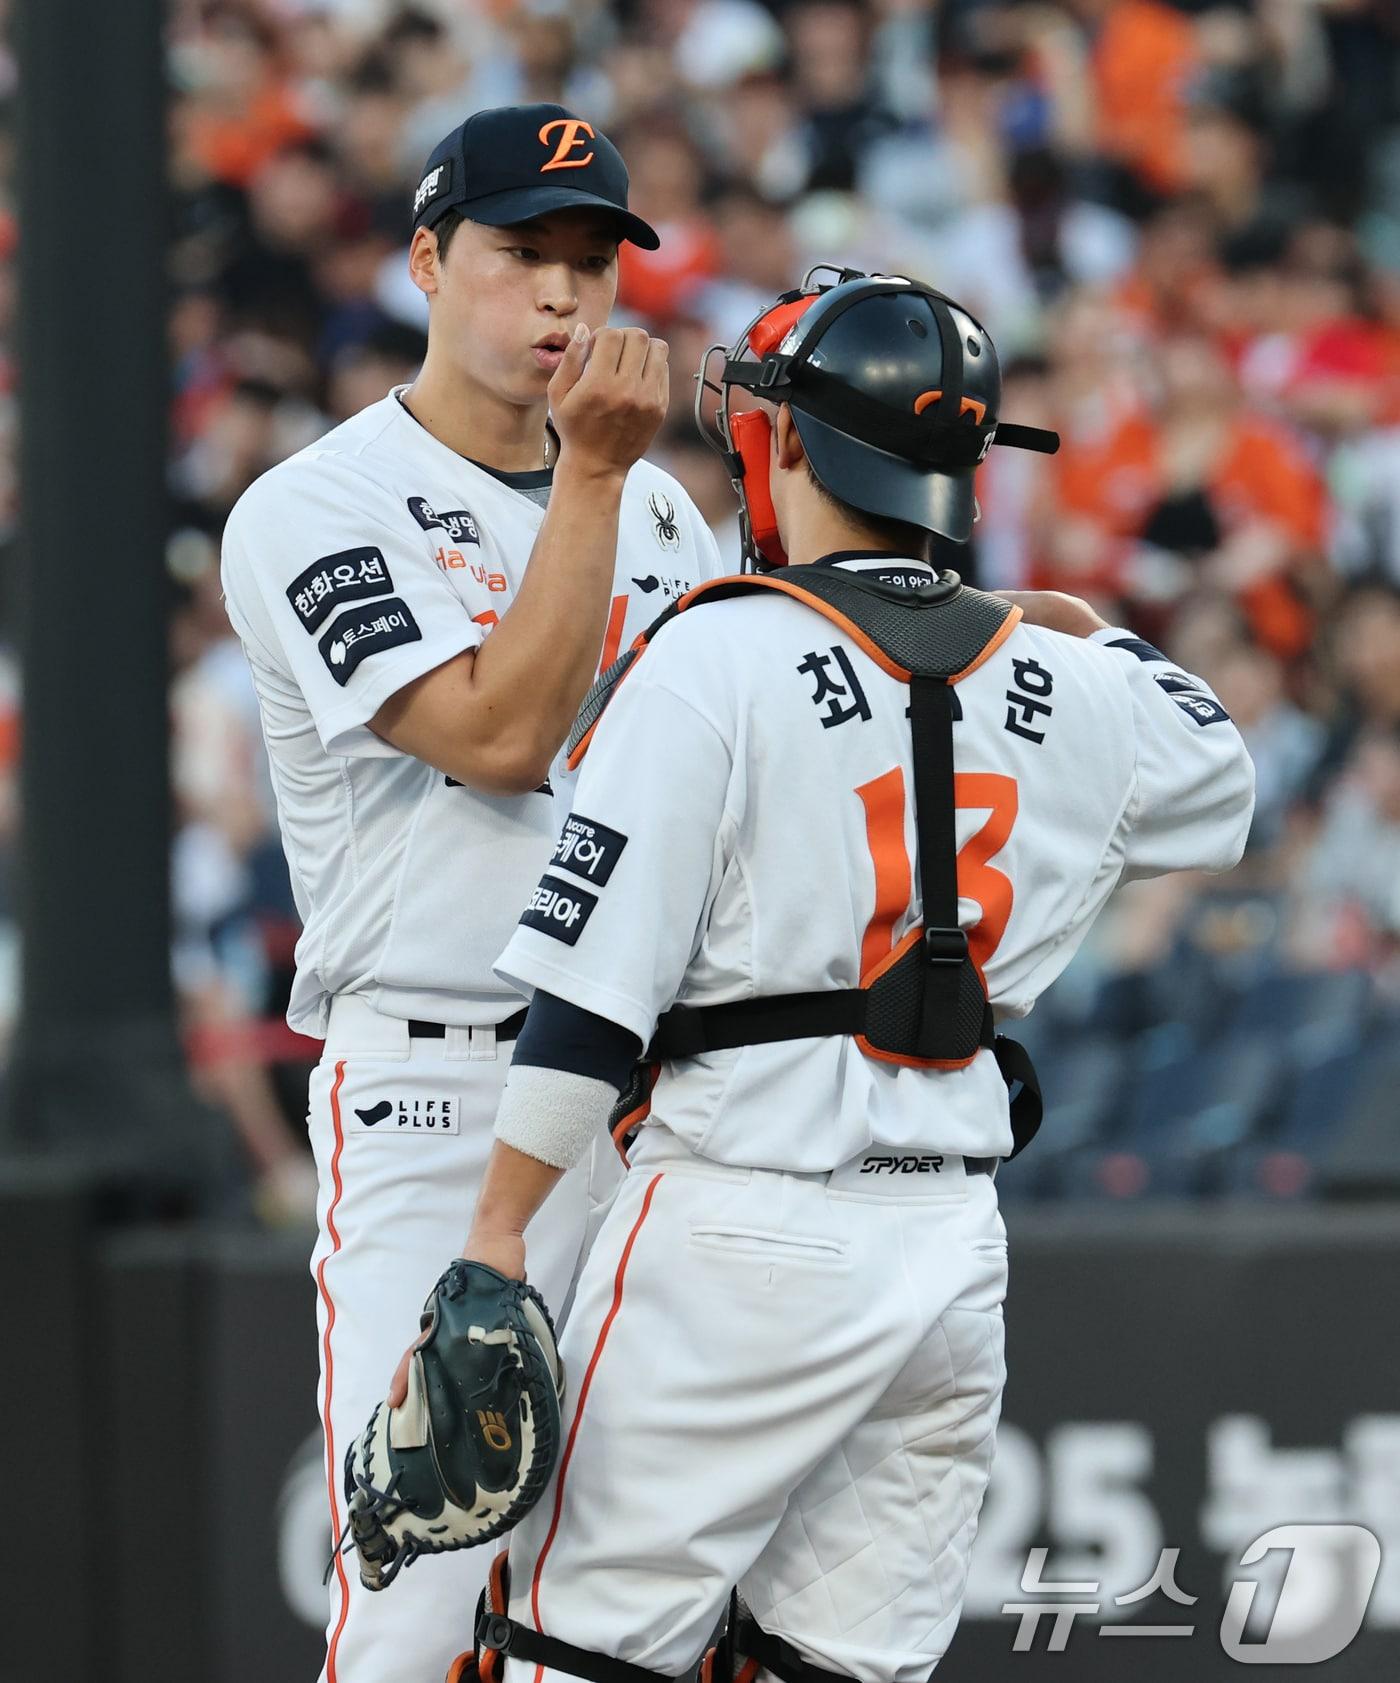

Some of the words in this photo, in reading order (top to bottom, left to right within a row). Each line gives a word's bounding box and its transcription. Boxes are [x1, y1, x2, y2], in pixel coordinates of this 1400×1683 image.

[539, 119, 595, 173] E
[294, 556, 386, 619] 한화오션
[661, 576, 691, 592] LIFE
[341, 610, 409, 650] 토스페이
[796, 645, 1054, 745] 최훈
[853, 763, 1020, 984] 13
[398, 1114, 451, 1128] PLUS
[399, 1100, 451, 1114] LIFE
[859, 1155, 945, 1175] SPYDER
